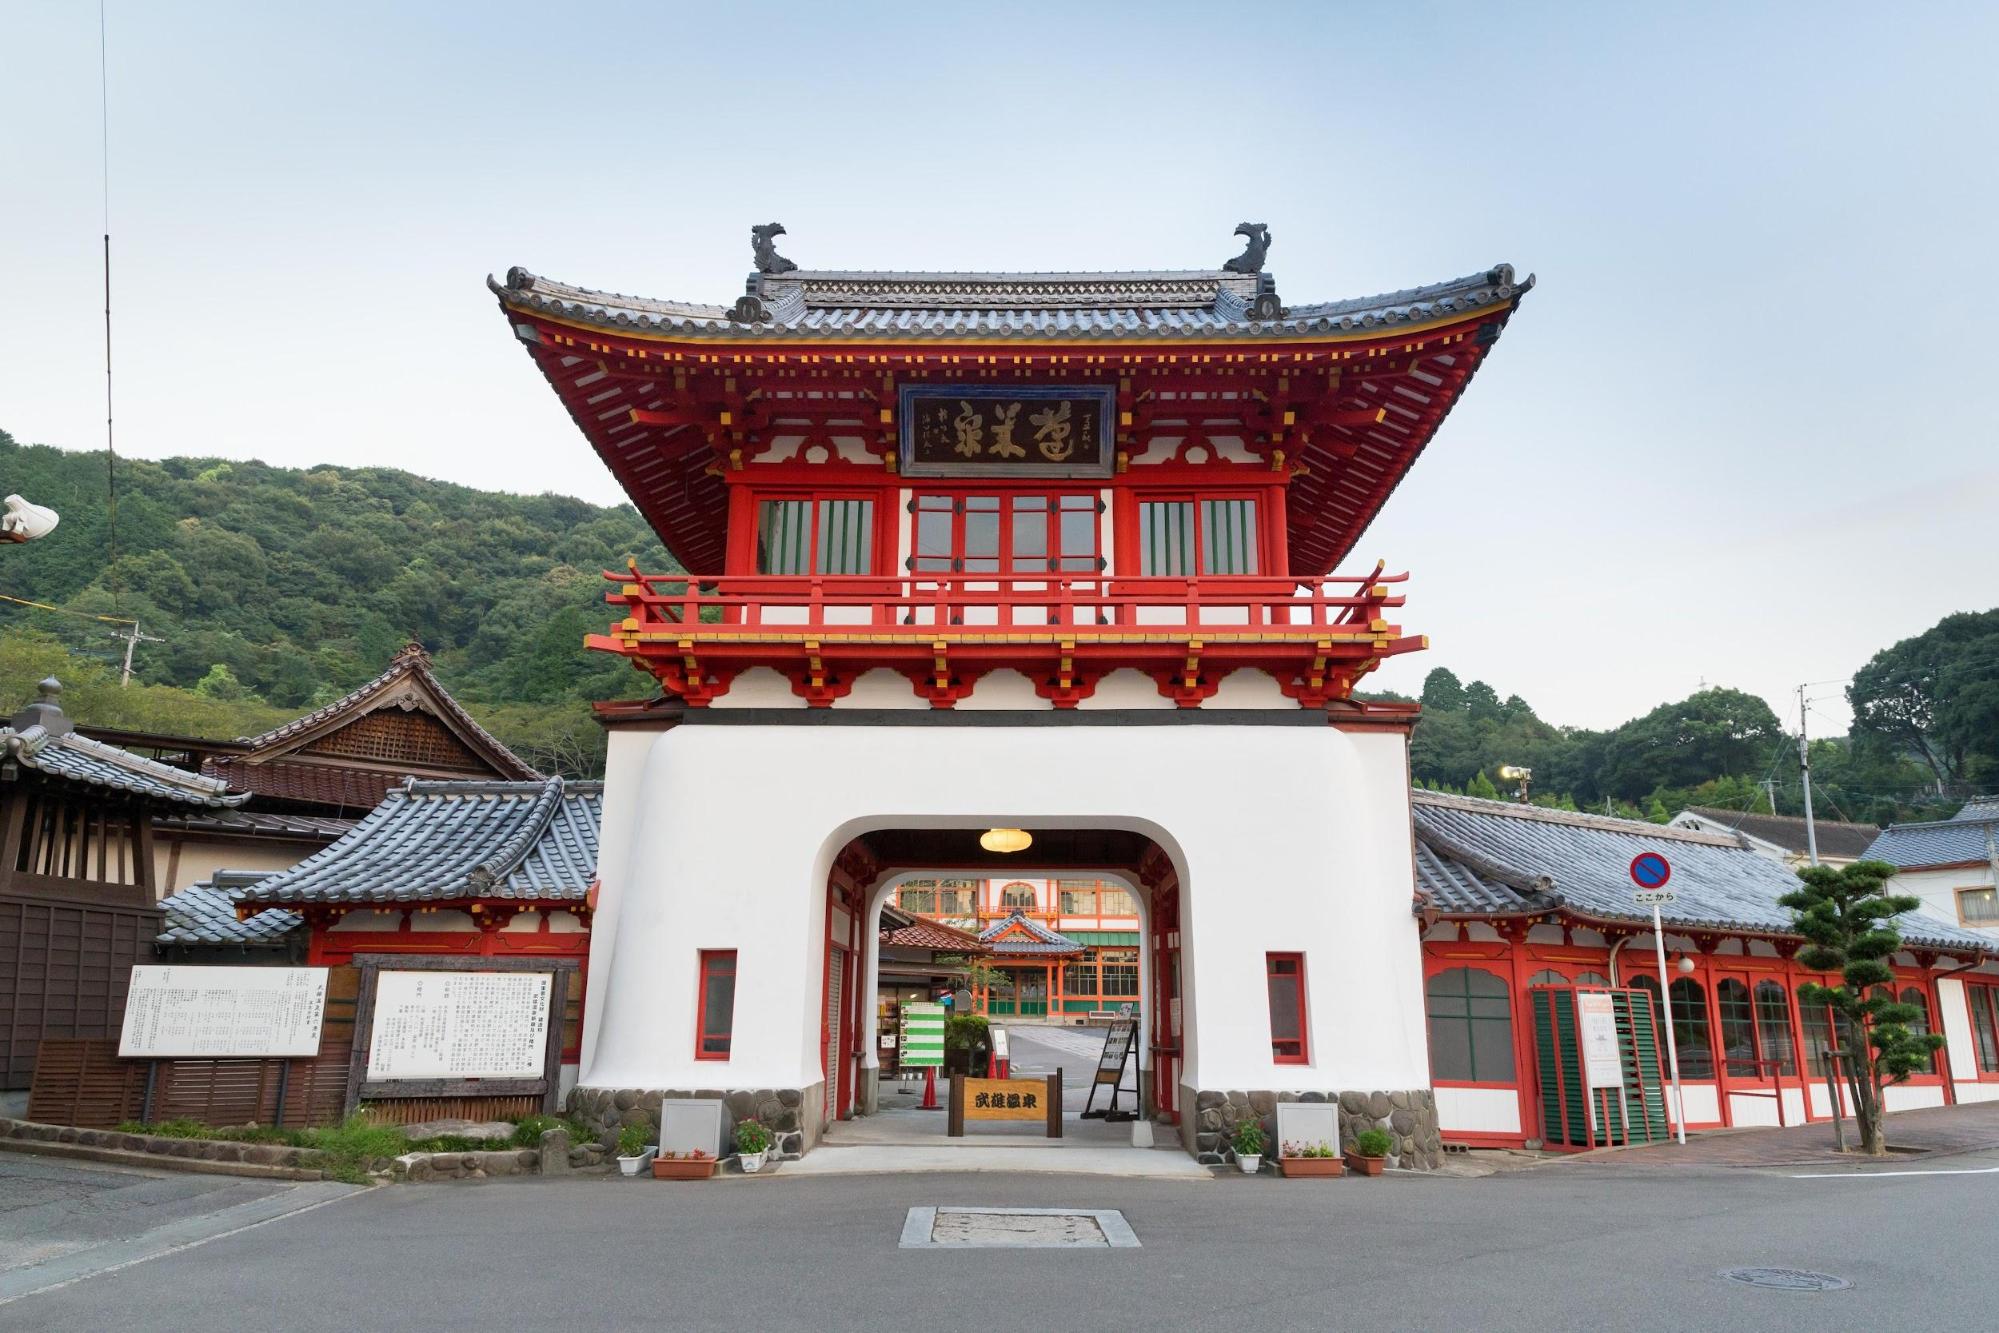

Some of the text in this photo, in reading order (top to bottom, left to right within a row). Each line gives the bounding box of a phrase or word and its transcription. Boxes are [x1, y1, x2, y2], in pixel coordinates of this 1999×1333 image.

[1636, 892, 1674, 902] ここから
[975, 1092, 1037, 1109] 武雄温泉
